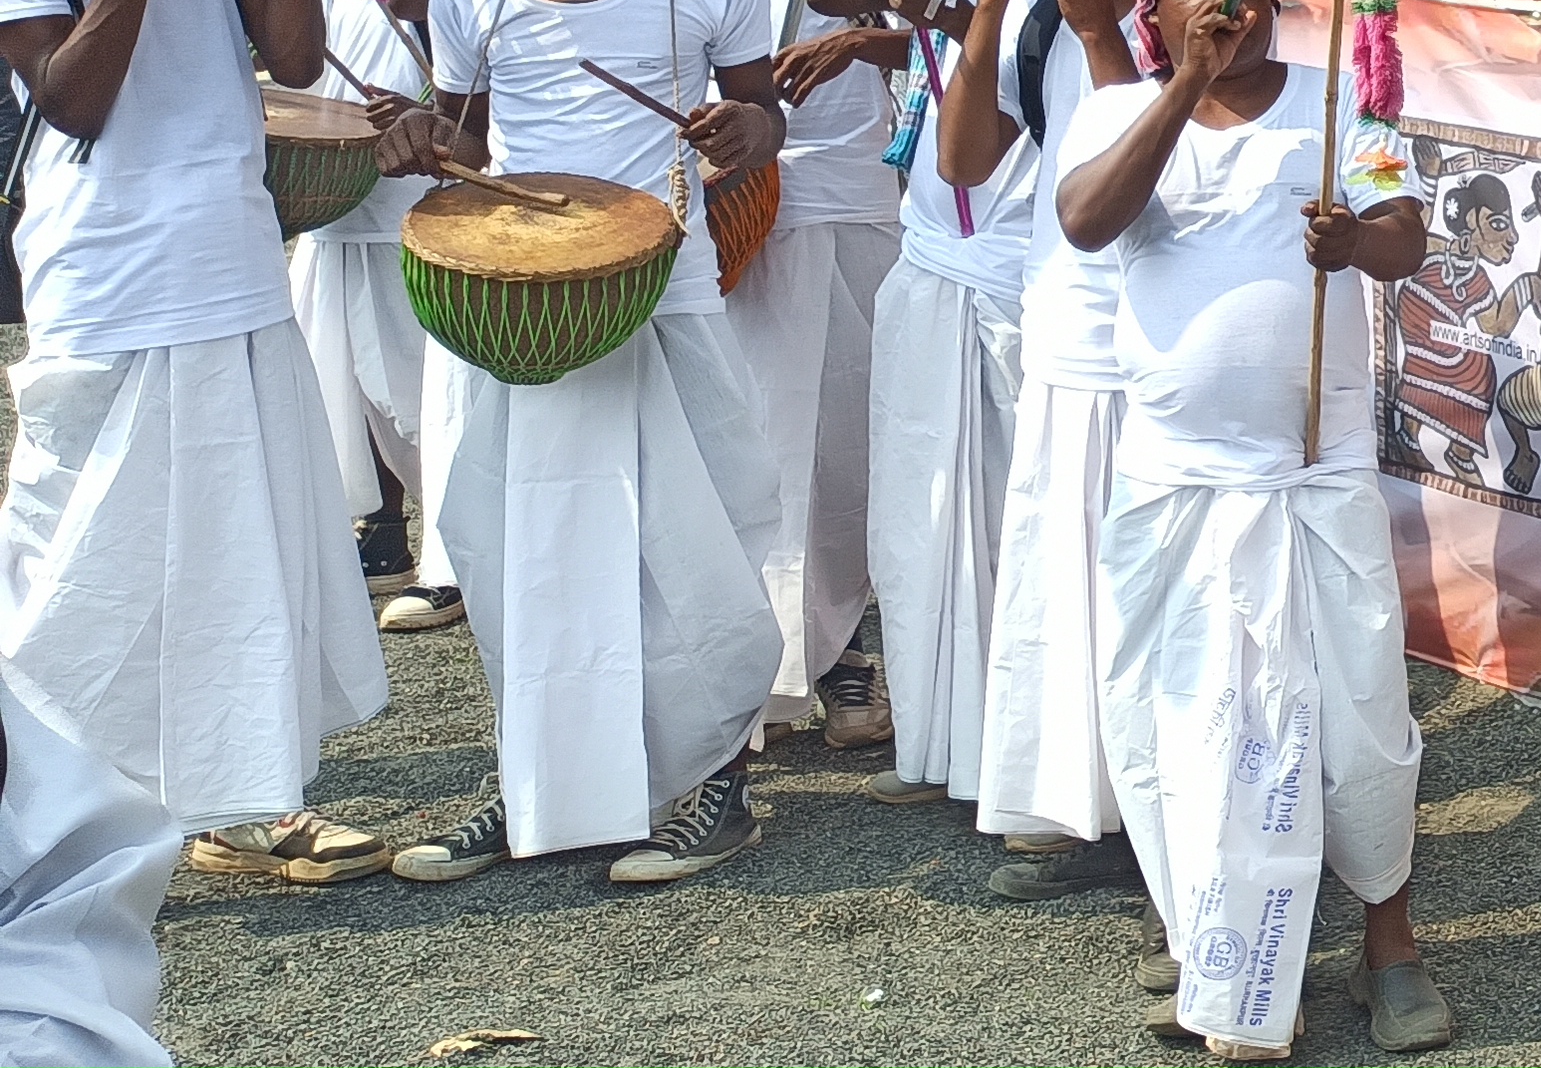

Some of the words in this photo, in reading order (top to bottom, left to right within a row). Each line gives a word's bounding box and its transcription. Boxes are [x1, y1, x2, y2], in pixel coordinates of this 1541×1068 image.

[1432, 325, 1537, 363] www.artsofindia.in
[1273, 888, 1294, 919] Shri
[1212, 941, 1233, 968] GB
[1258, 924, 1286, 985] Vinayak
[1249, 990, 1273, 1027] Mills
